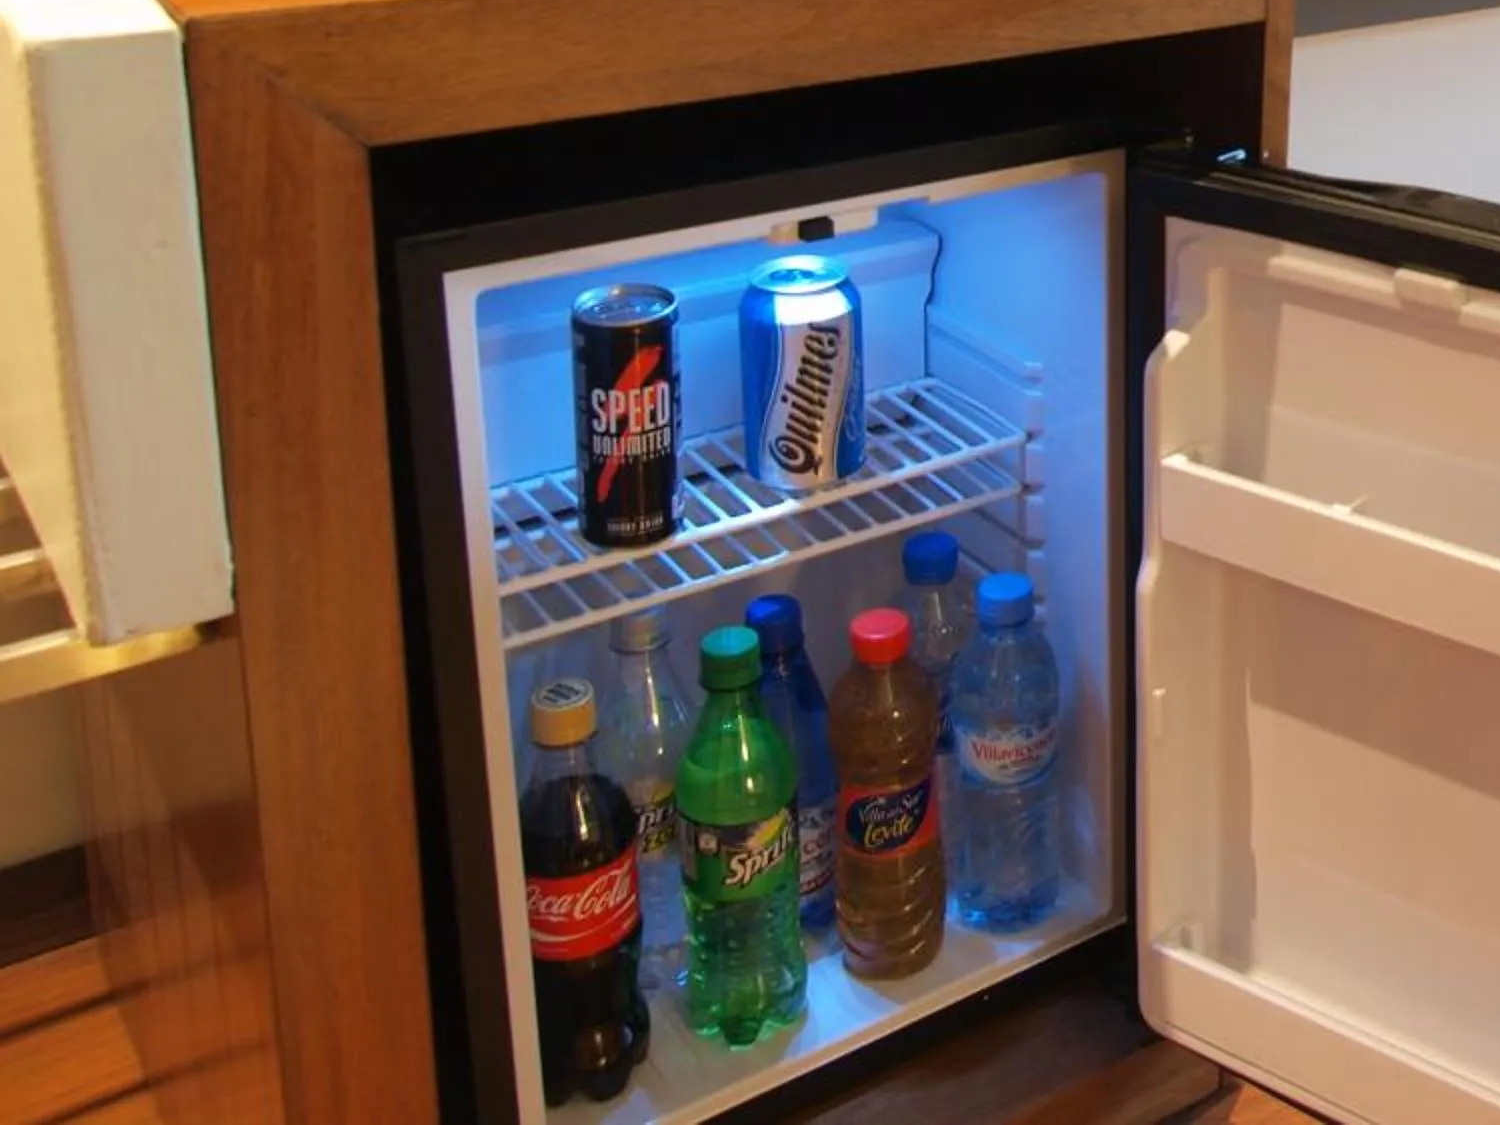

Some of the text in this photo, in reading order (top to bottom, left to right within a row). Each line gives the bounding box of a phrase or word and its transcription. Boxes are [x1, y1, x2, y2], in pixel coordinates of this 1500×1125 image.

[591, 379, 671, 433] SPEED
[768, 322, 841, 477] Quilmes
[592, 426, 672, 456] UNLIMITED
